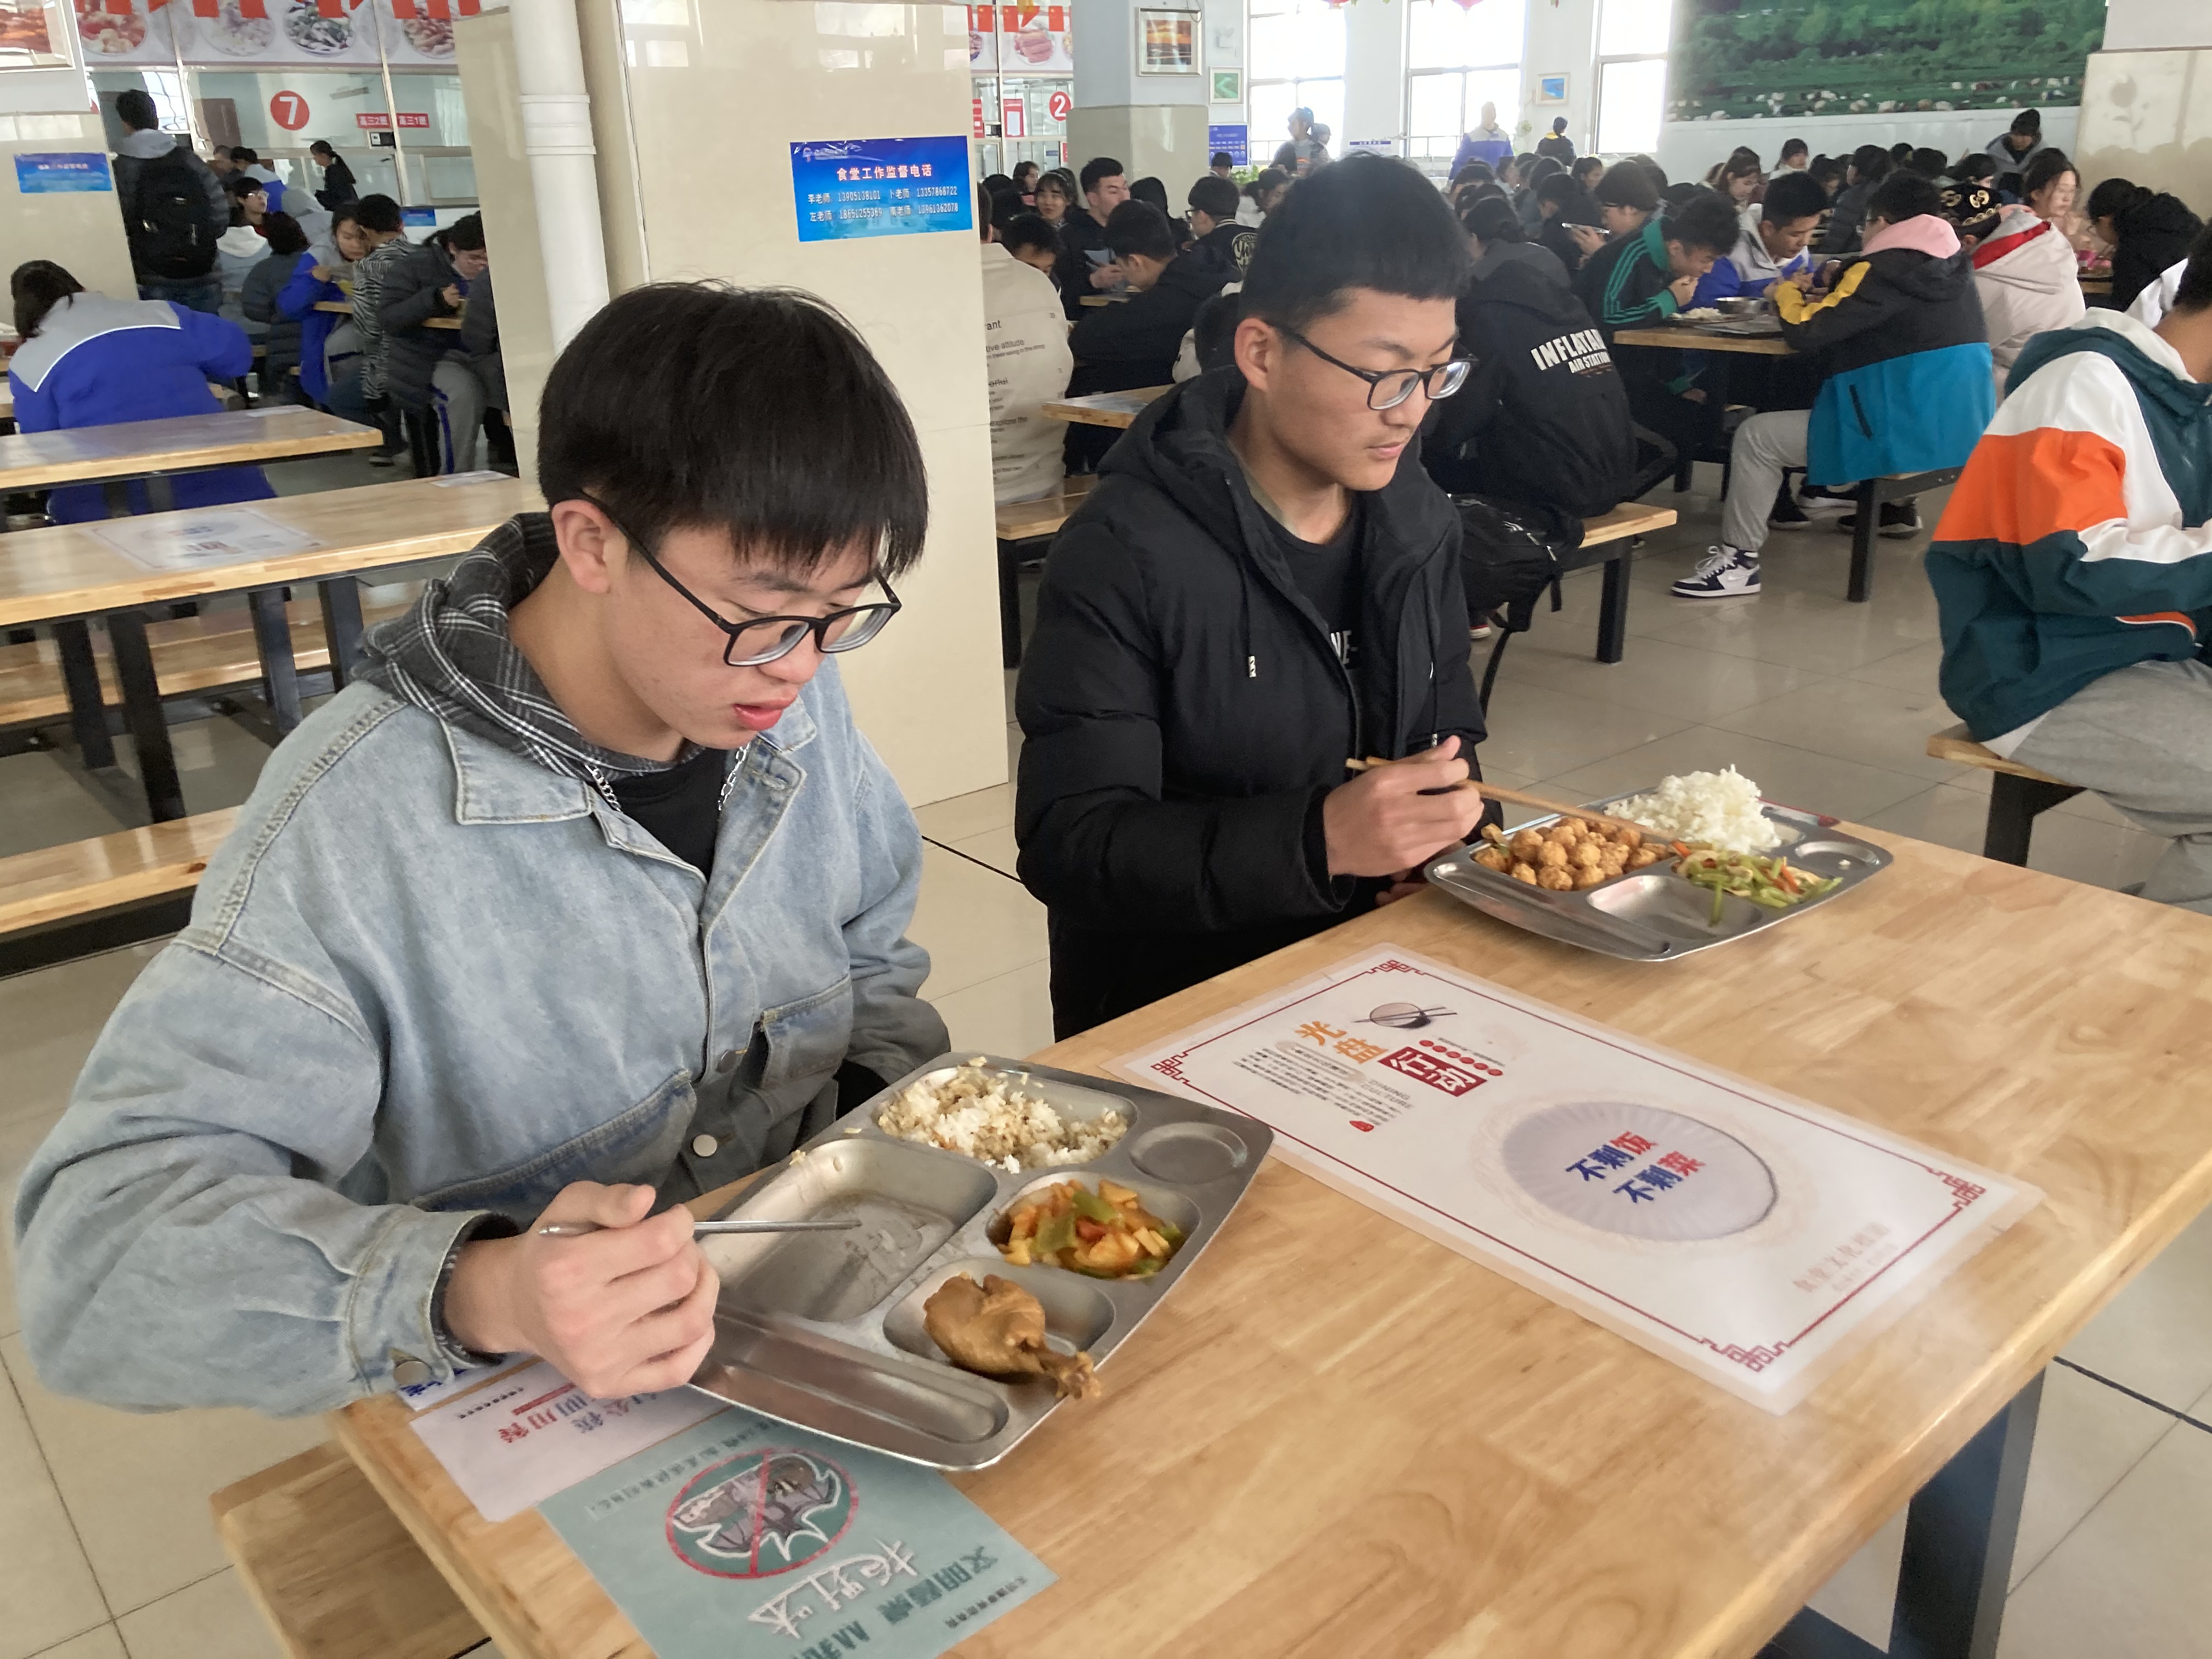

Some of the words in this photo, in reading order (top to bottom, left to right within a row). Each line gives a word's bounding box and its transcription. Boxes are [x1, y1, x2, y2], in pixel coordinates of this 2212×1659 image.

[279, 96, 298, 125] 7
[1053, 94, 1066, 117] 2
[837, 164, 933, 181] 食堂工作监督电话
[1001, 339, 1024, 349] attitude
[1565, 1130, 1659, 1182] 不剩饭
[1612, 1150, 1706, 1204] 不剩菜
